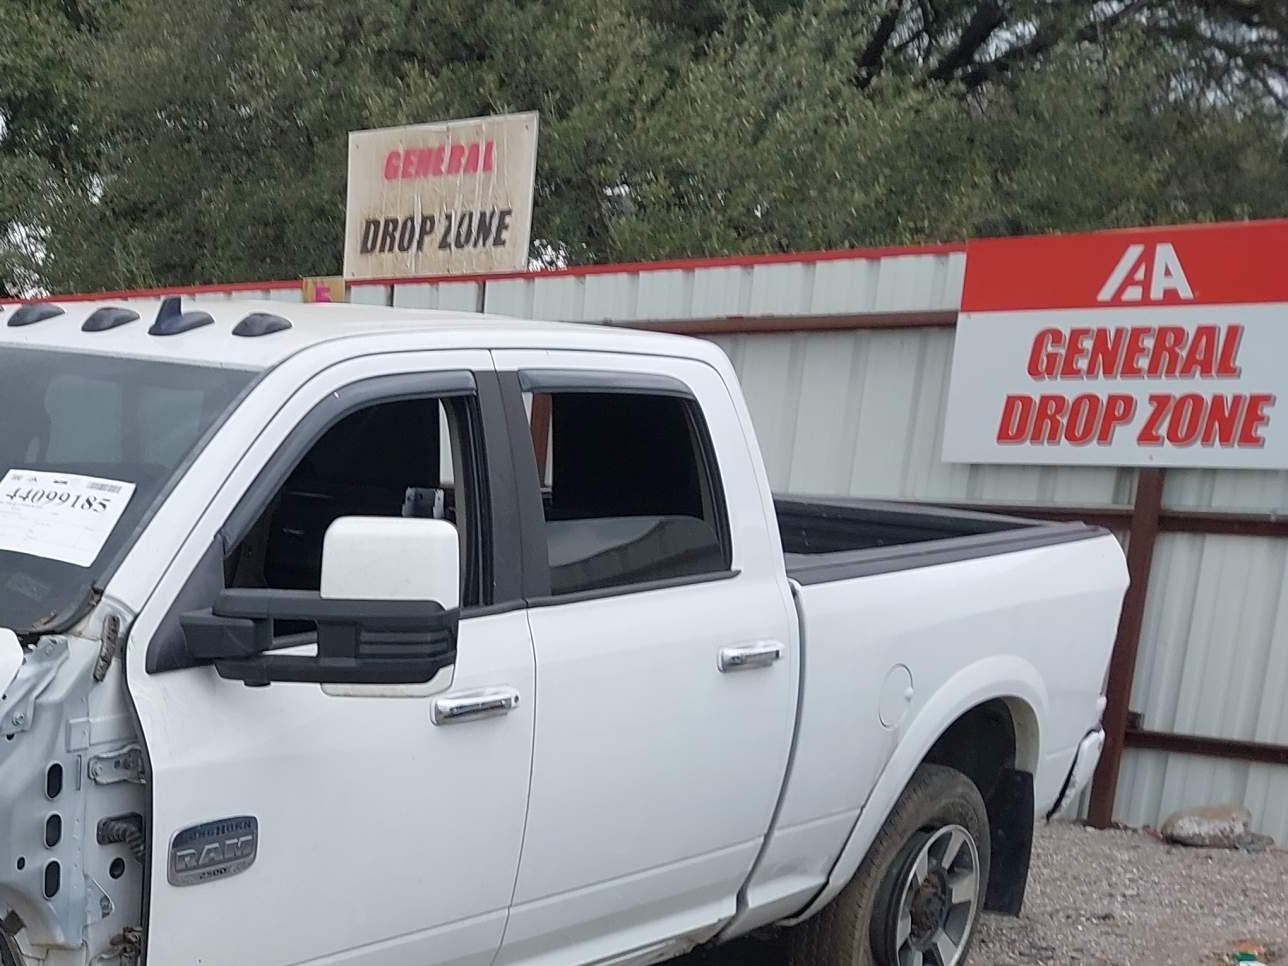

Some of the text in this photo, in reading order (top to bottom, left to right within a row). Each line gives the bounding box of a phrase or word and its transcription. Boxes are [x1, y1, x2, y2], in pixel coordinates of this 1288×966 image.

[383, 139, 494, 181] GENERAL
[360, 208, 512, 254] DROP ZONE
[1026, 323, 1245, 380] GENERAL
[995, 393, 1277, 448] DROP ZONE
[6, 487, 112, 513] 44099185
[175, 835, 253, 872] RAM
